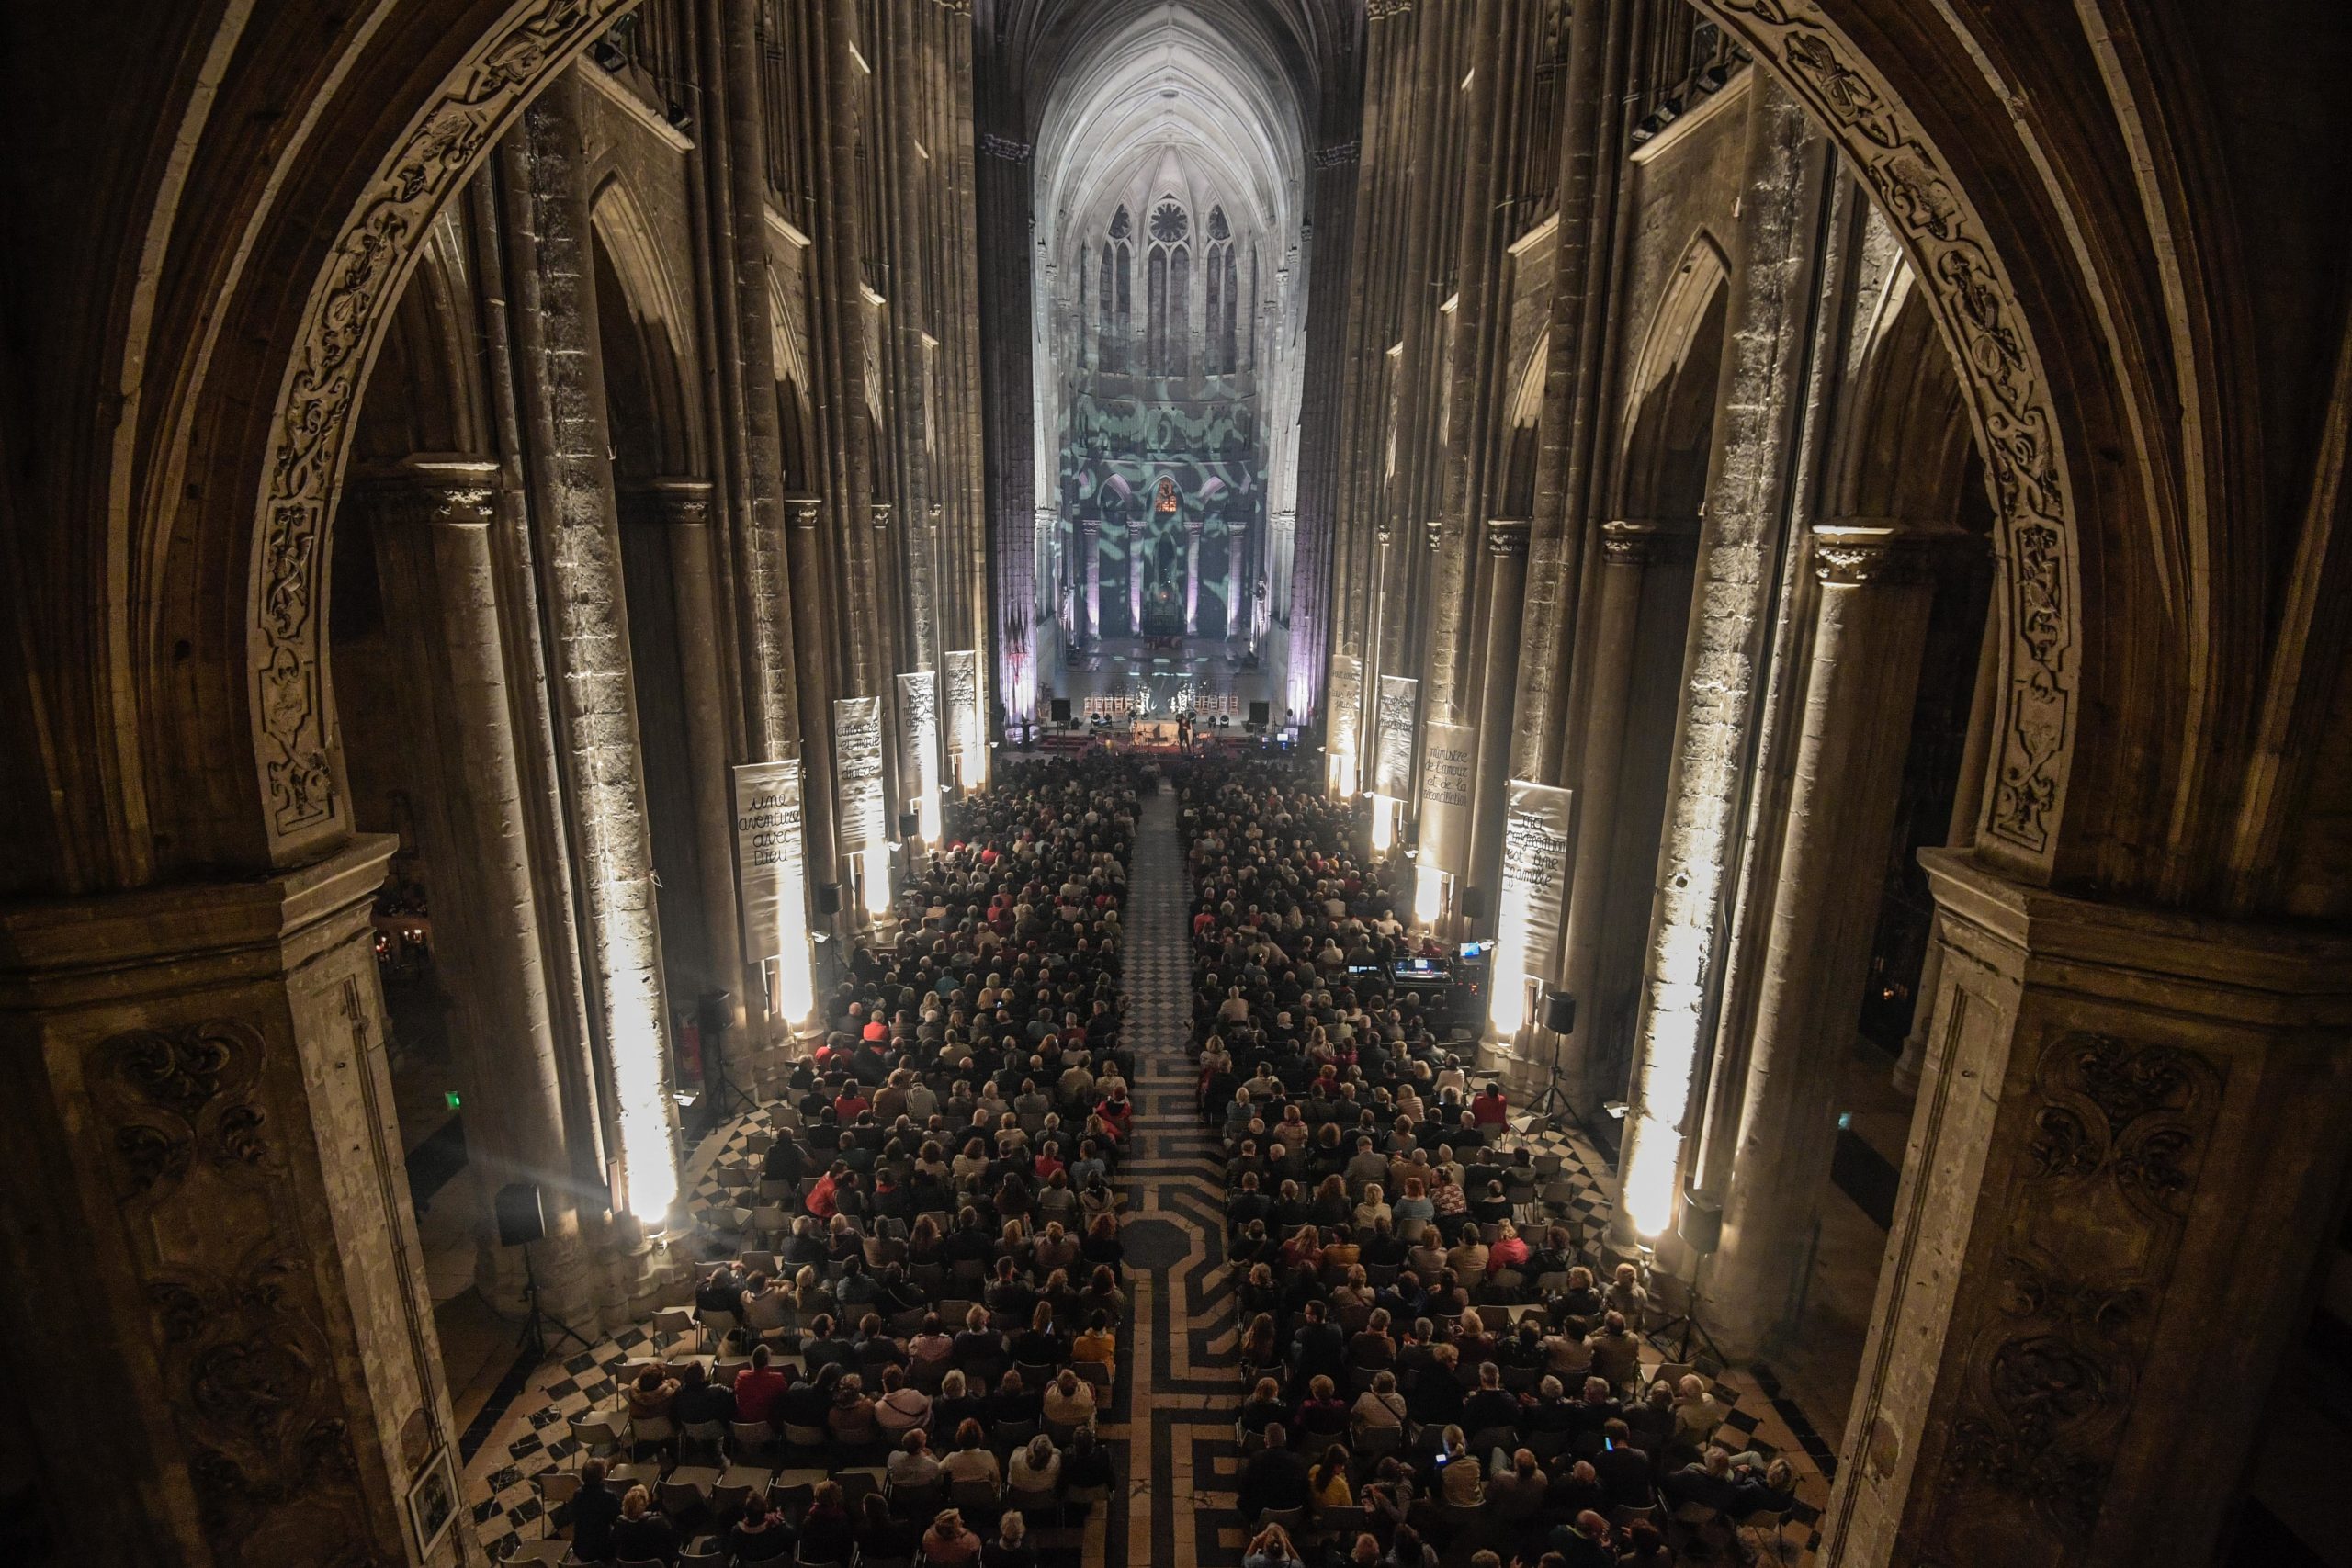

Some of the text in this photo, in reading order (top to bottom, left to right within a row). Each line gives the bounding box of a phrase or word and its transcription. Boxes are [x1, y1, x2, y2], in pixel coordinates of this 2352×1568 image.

[1430, 746, 1468, 762] ministre
[1425, 758, 1468, 777] de l'amour
[1427, 775, 1467, 792] et de la
[749, 794, 788, 811] une
[1423, 788, 1467, 807] réconciliation
[738, 810, 800, 831] aventure
[752, 830, 792, 848] avec
[754, 849, 788, 866] Dieu
[1507, 848, 1559, 871] est une
